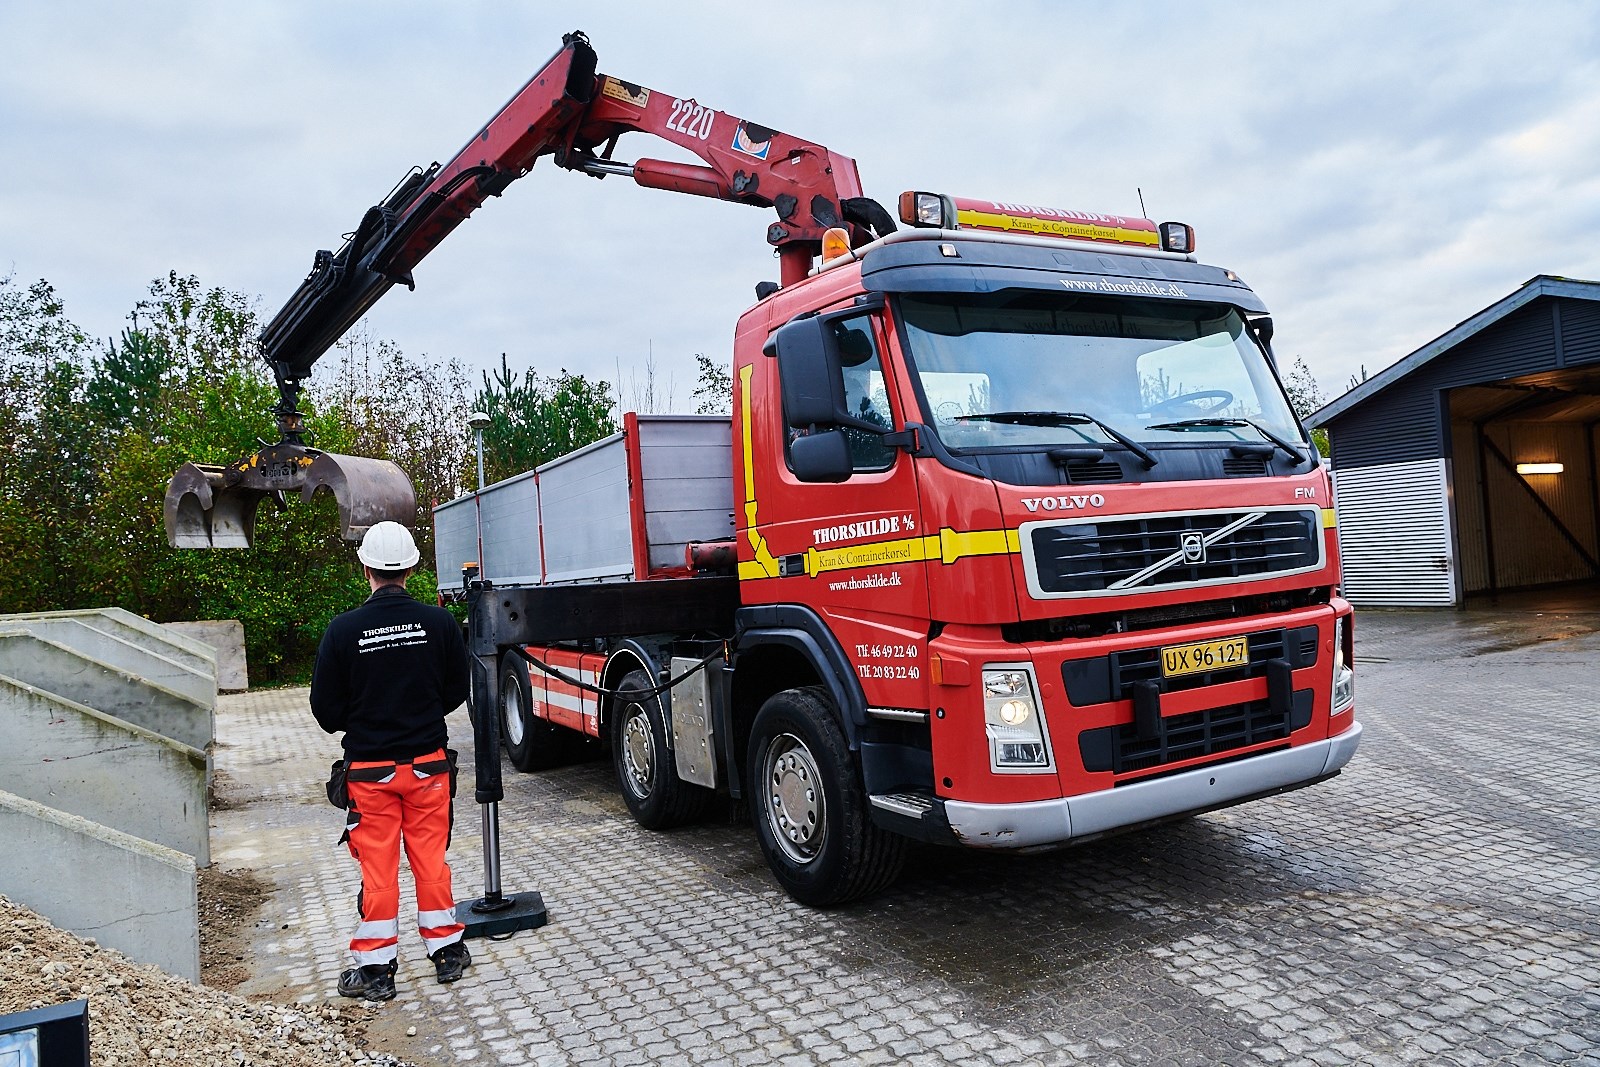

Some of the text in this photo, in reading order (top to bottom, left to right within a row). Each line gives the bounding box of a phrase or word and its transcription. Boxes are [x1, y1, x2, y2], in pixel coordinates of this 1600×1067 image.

[666, 98, 715, 140] 2220
[1042, 223, 1050, 231] &
[1060, 277, 1188, 299] www.thorskilde.dk
[1294, 486, 1316, 500] FM
[1021, 493, 1105, 513] VOLVO
[813, 516, 900, 544] THORSKILDE
[819, 556, 836, 568] Kran
[837, 554, 845, 566] &
[829, 572, 902, 591] www.thorskilde.dk
[363, 623, 413, 637] THORSKILDE
[855, 644, 918, 658] Tlf. 46 49 22 40
[1164, 641, 1245, 671] UX 96 127
[857, 665, 920, 680] Tlf. 20 83 22 40
